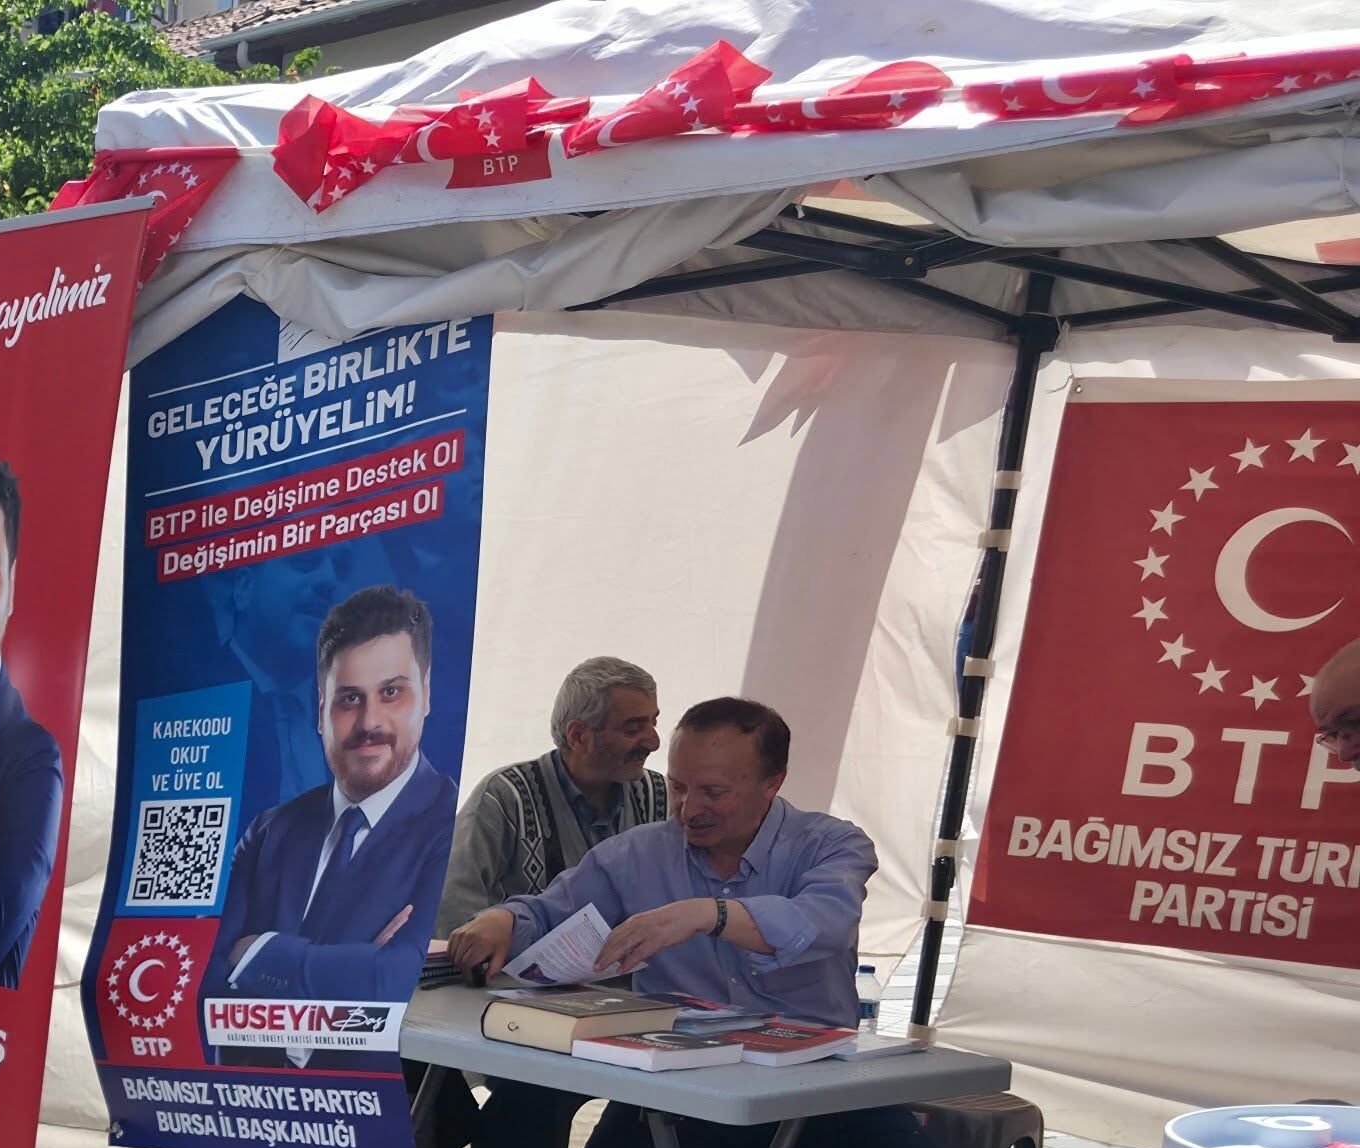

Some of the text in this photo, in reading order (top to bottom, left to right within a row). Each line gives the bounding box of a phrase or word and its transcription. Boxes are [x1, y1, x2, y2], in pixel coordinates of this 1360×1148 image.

[483, 155, 518, 176] BTP
[147, 374, 297, 439] GELECEĞE
[150, 439, 459, 541] BTP ile Değişime Destek Ol
[163, 487, 439, 577] Değişimin Bir Parçası Ol
[152, 717, 232, 740] KAREKODU
[170, 745, 210, 766] OKUT
[1121, 721, 1360, 811] BTP
[152, 769, 224, 793] VE ÜYE OL
[1007, 816, 1360, 889] BAĞIMSIZ TÜR
[131, 1036, 172, 1057] BTP
[121, 1076, 213, 1105] BAĞIMSIZ
[156, 1111, 357, 1148] BURSA İL BAŞKANLIĞI
